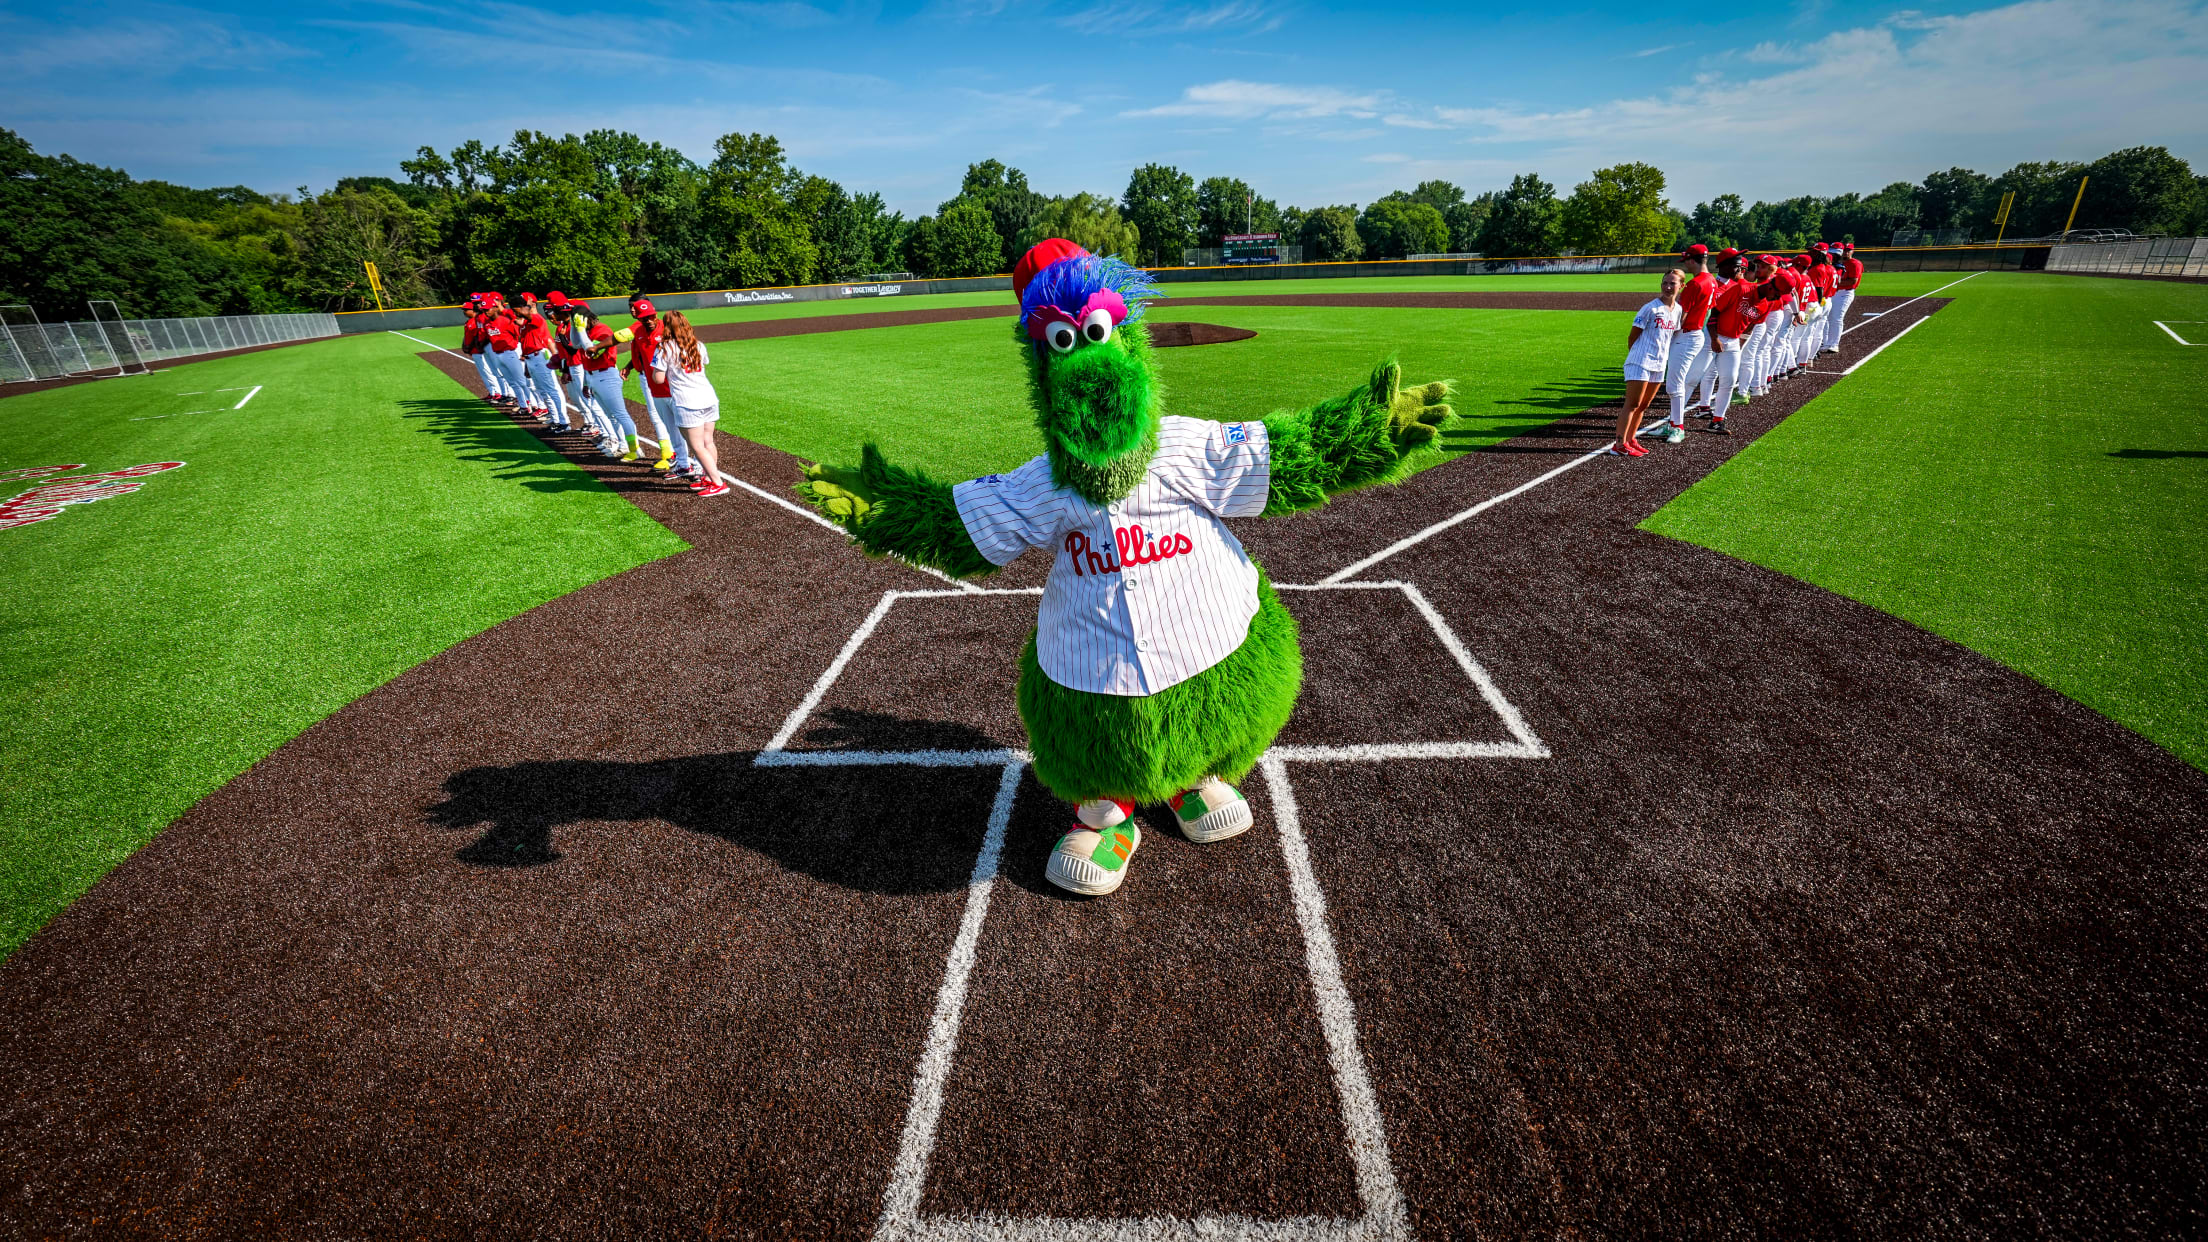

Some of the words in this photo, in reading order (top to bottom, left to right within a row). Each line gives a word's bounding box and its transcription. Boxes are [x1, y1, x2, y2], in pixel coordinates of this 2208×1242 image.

[852, 286, 878, 294] TOGETHER
[724, 292, 752, 303] Phillies
[1064, 523, 1193, 577] Phillies
